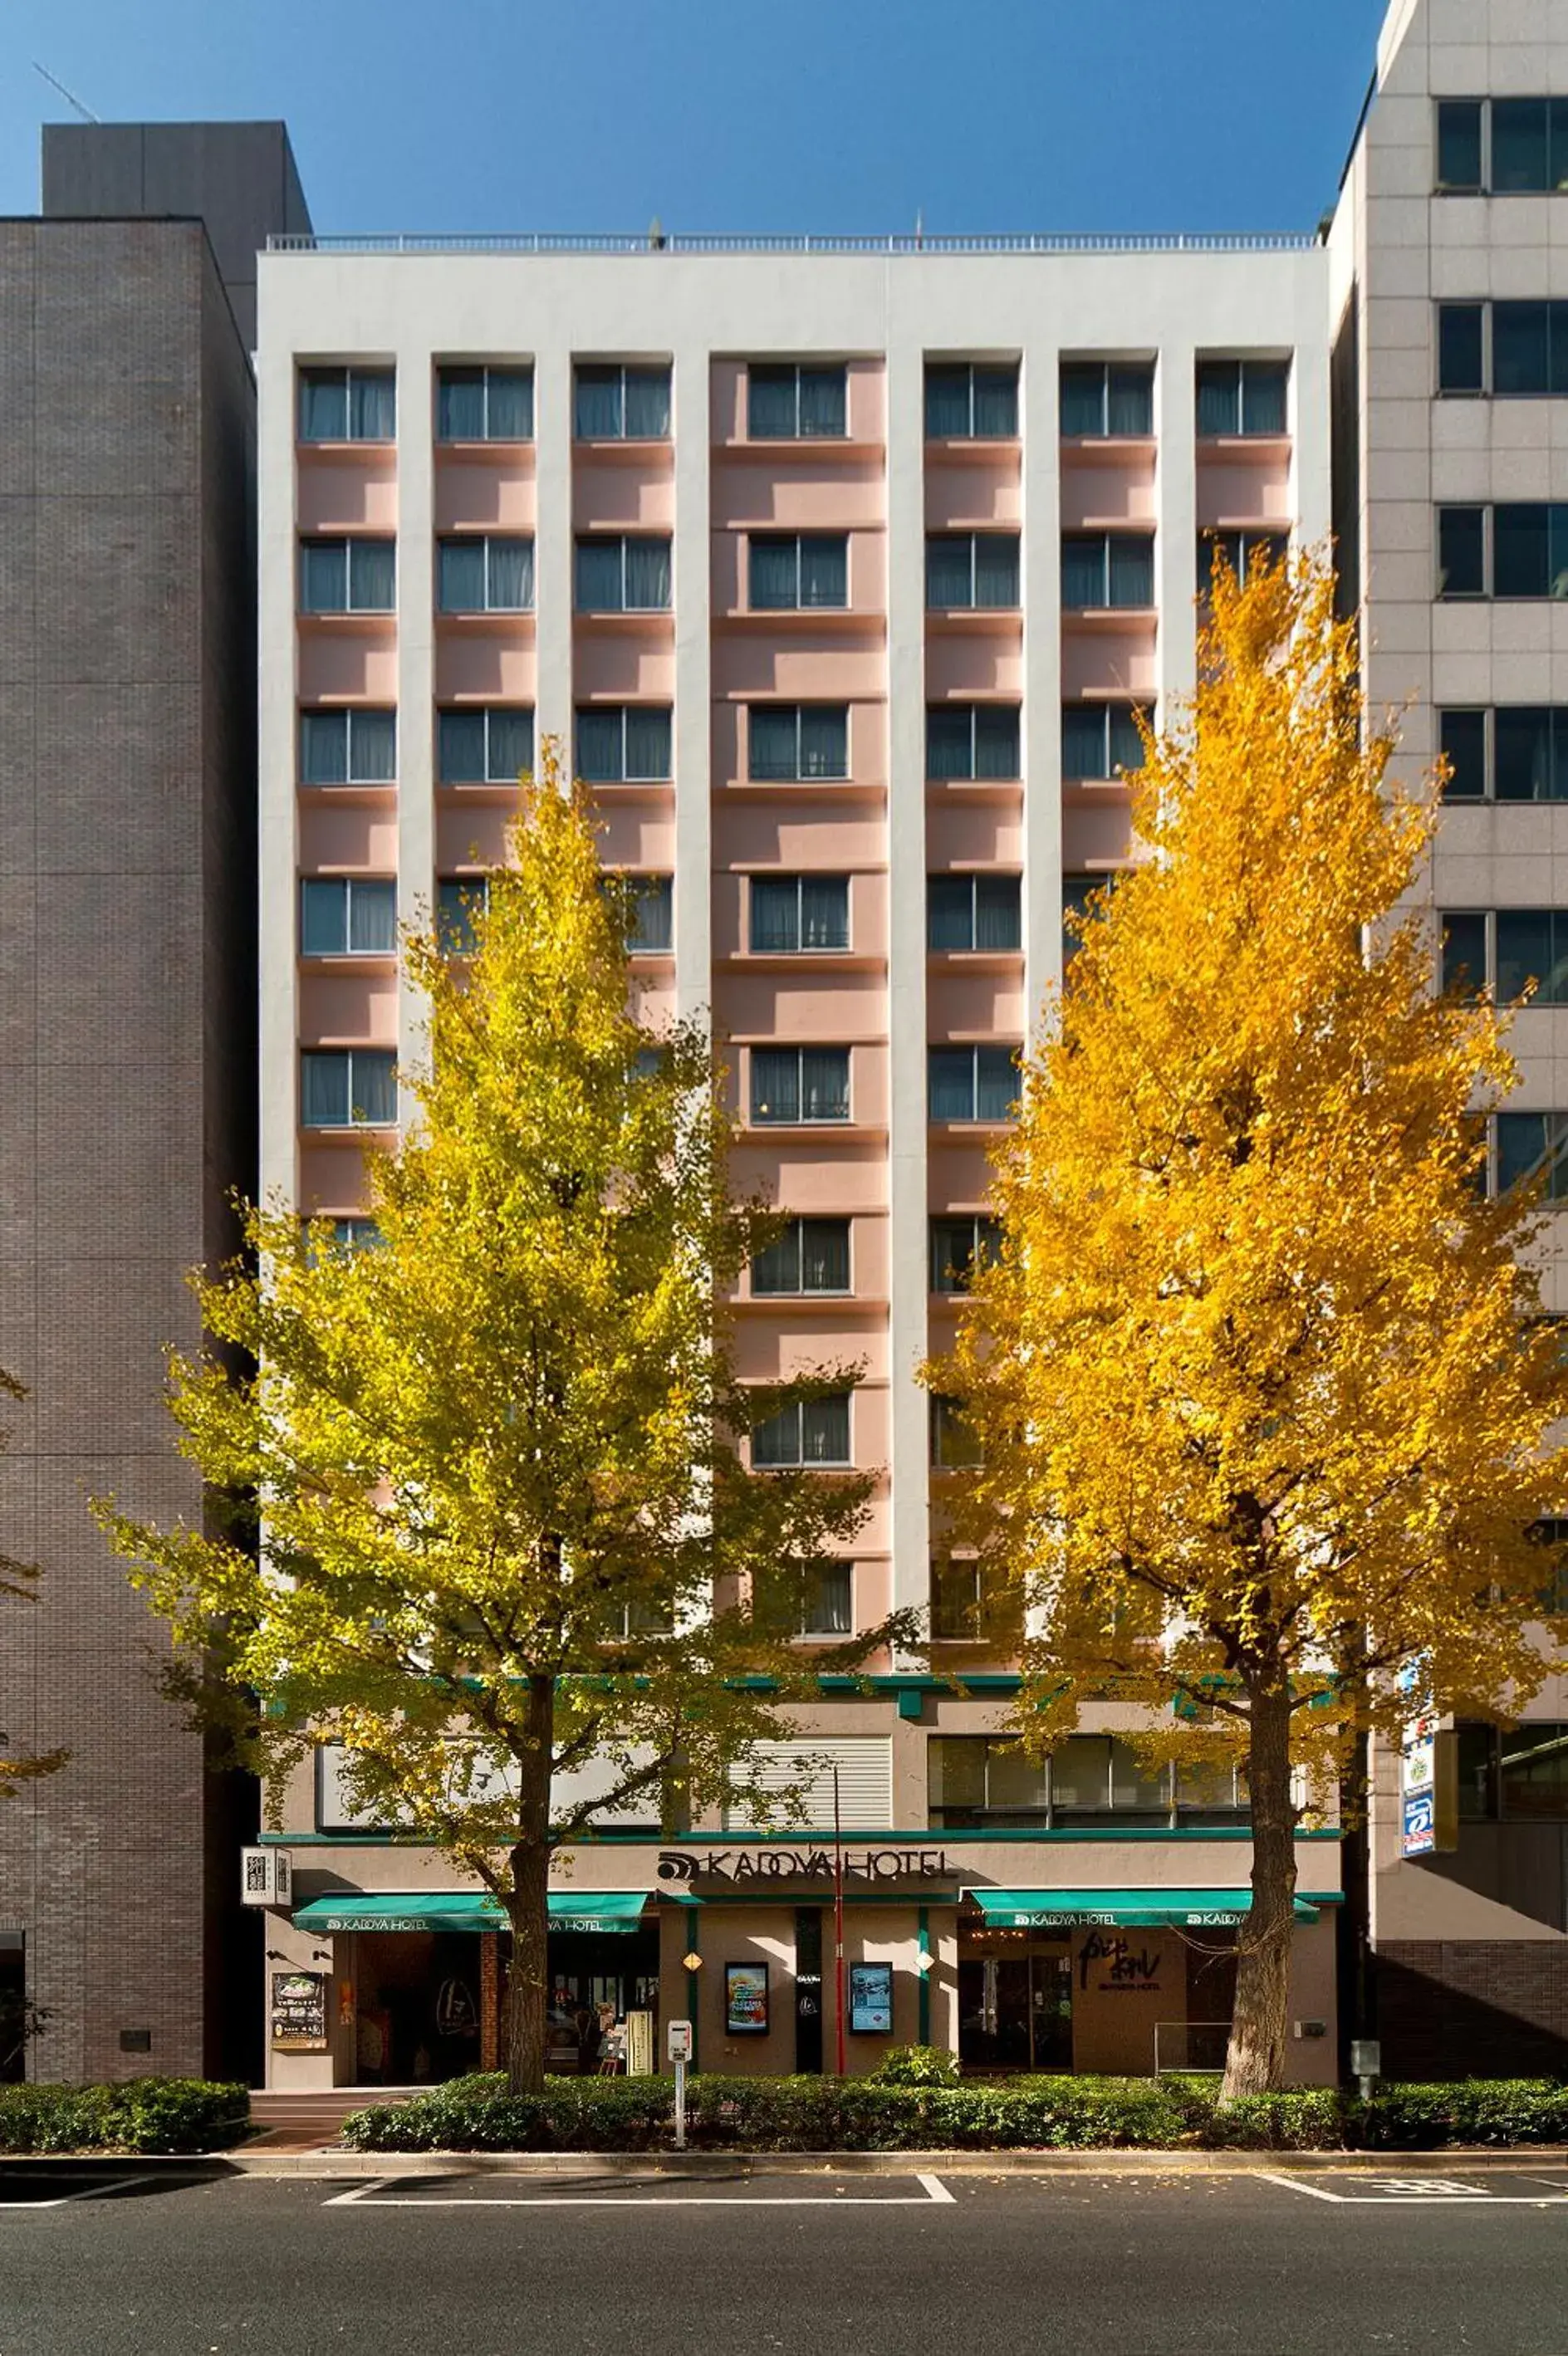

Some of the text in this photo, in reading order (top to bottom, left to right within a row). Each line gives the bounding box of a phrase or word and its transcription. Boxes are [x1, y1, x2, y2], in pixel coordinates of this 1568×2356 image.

[708, 1851, 958, 1879] KADOYA HOTEL
[343, 1918, 429, 1930] KADOYA HOTEL
[1031, 1913, 1117, 1925] KADOYA HOTEL
[566, 1920, 602, 1931] HOTEL
